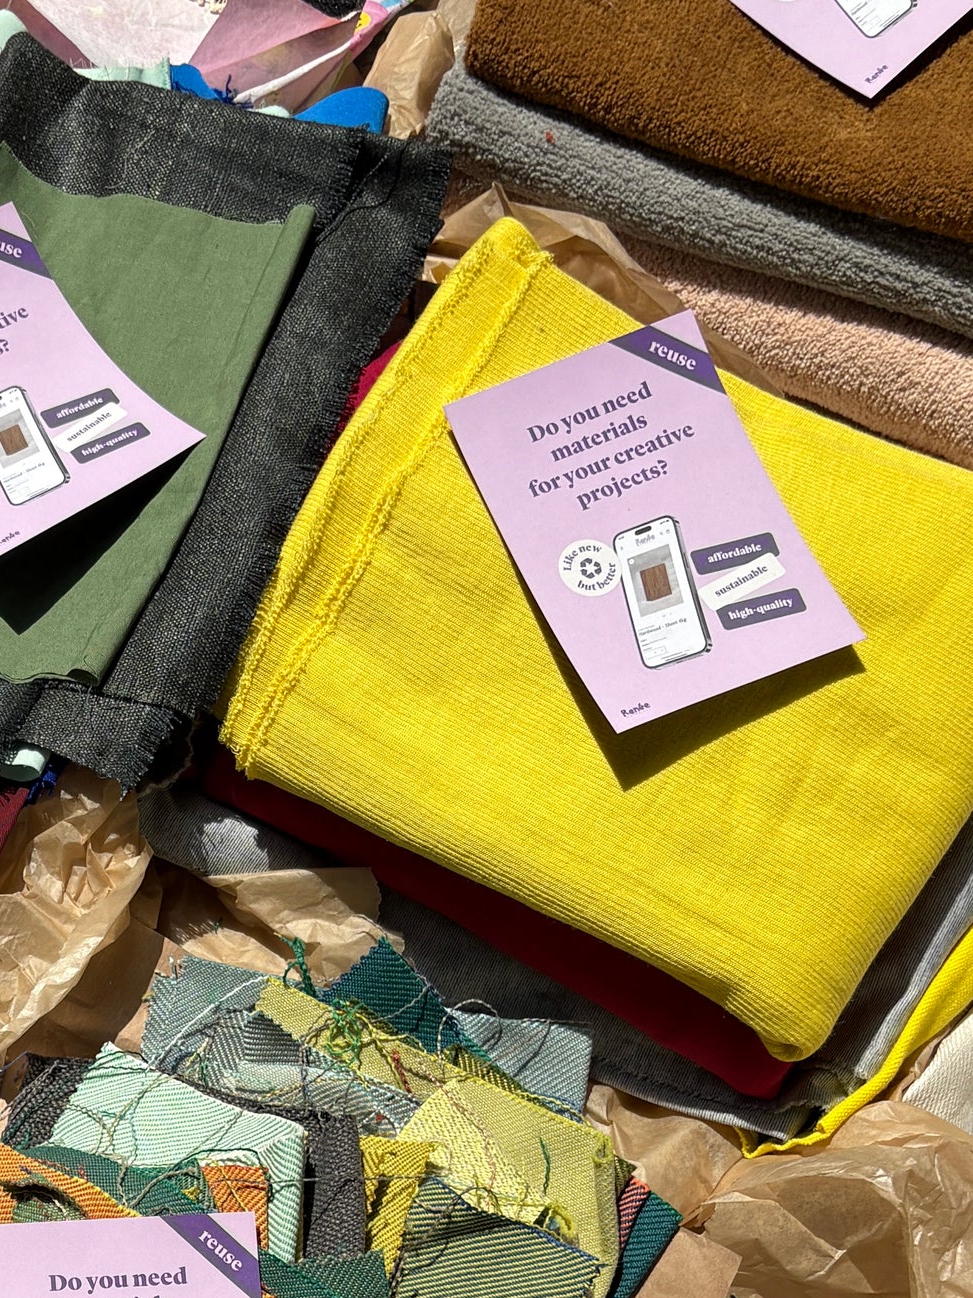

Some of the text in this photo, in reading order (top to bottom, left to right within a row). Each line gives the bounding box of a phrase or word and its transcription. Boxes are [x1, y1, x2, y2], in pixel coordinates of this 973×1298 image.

[649, 341, 696, 370] reuse
[56, 398, 103, 418] affordable
[526, 380, 653, 443] Do you need
[66, 412, 113, 441] sustainable
[550, 414, 648, 462] materials
[81, 430, 137, 456] high-quality
[529, 425, 695, 497] for your creative
[576, 460, 667, 511] projects?
[562, 544, 603, 572] Like new
[708, 543, 762, 563] affordable
[576, 561, 617, 592] but better
[714, 566, 769, 597] sustainable
[728, 599, 792, 620] high-quality
[198, 1230, 242, 1271] reuse
[48, 1266, 188, 1295] Do you need
